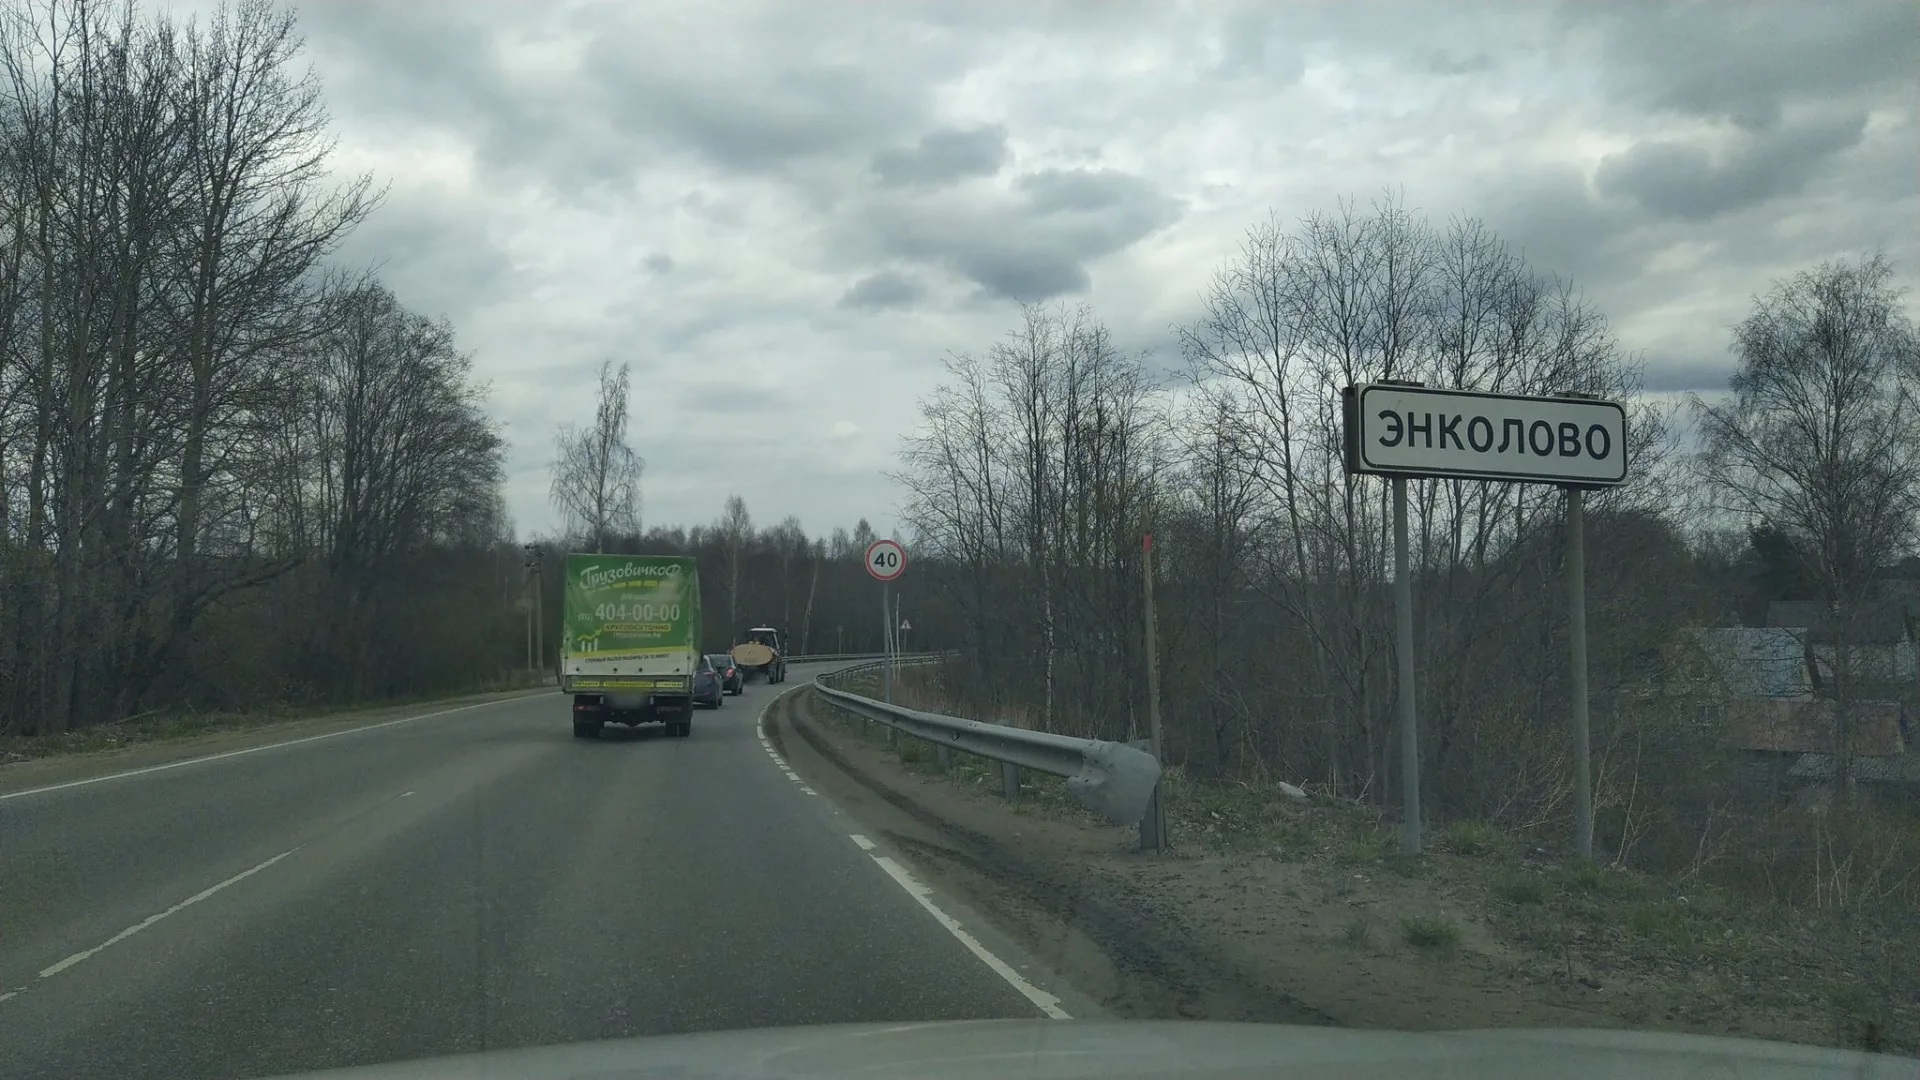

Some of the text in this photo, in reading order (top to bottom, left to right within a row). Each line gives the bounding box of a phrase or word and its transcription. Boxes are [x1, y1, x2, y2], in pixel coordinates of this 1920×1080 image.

[1378, 409, 1611, 461] ЭНКОЛОВО
[874, 552, 898, 568] 40
[595, 603, 680, 621] 404-00-00
